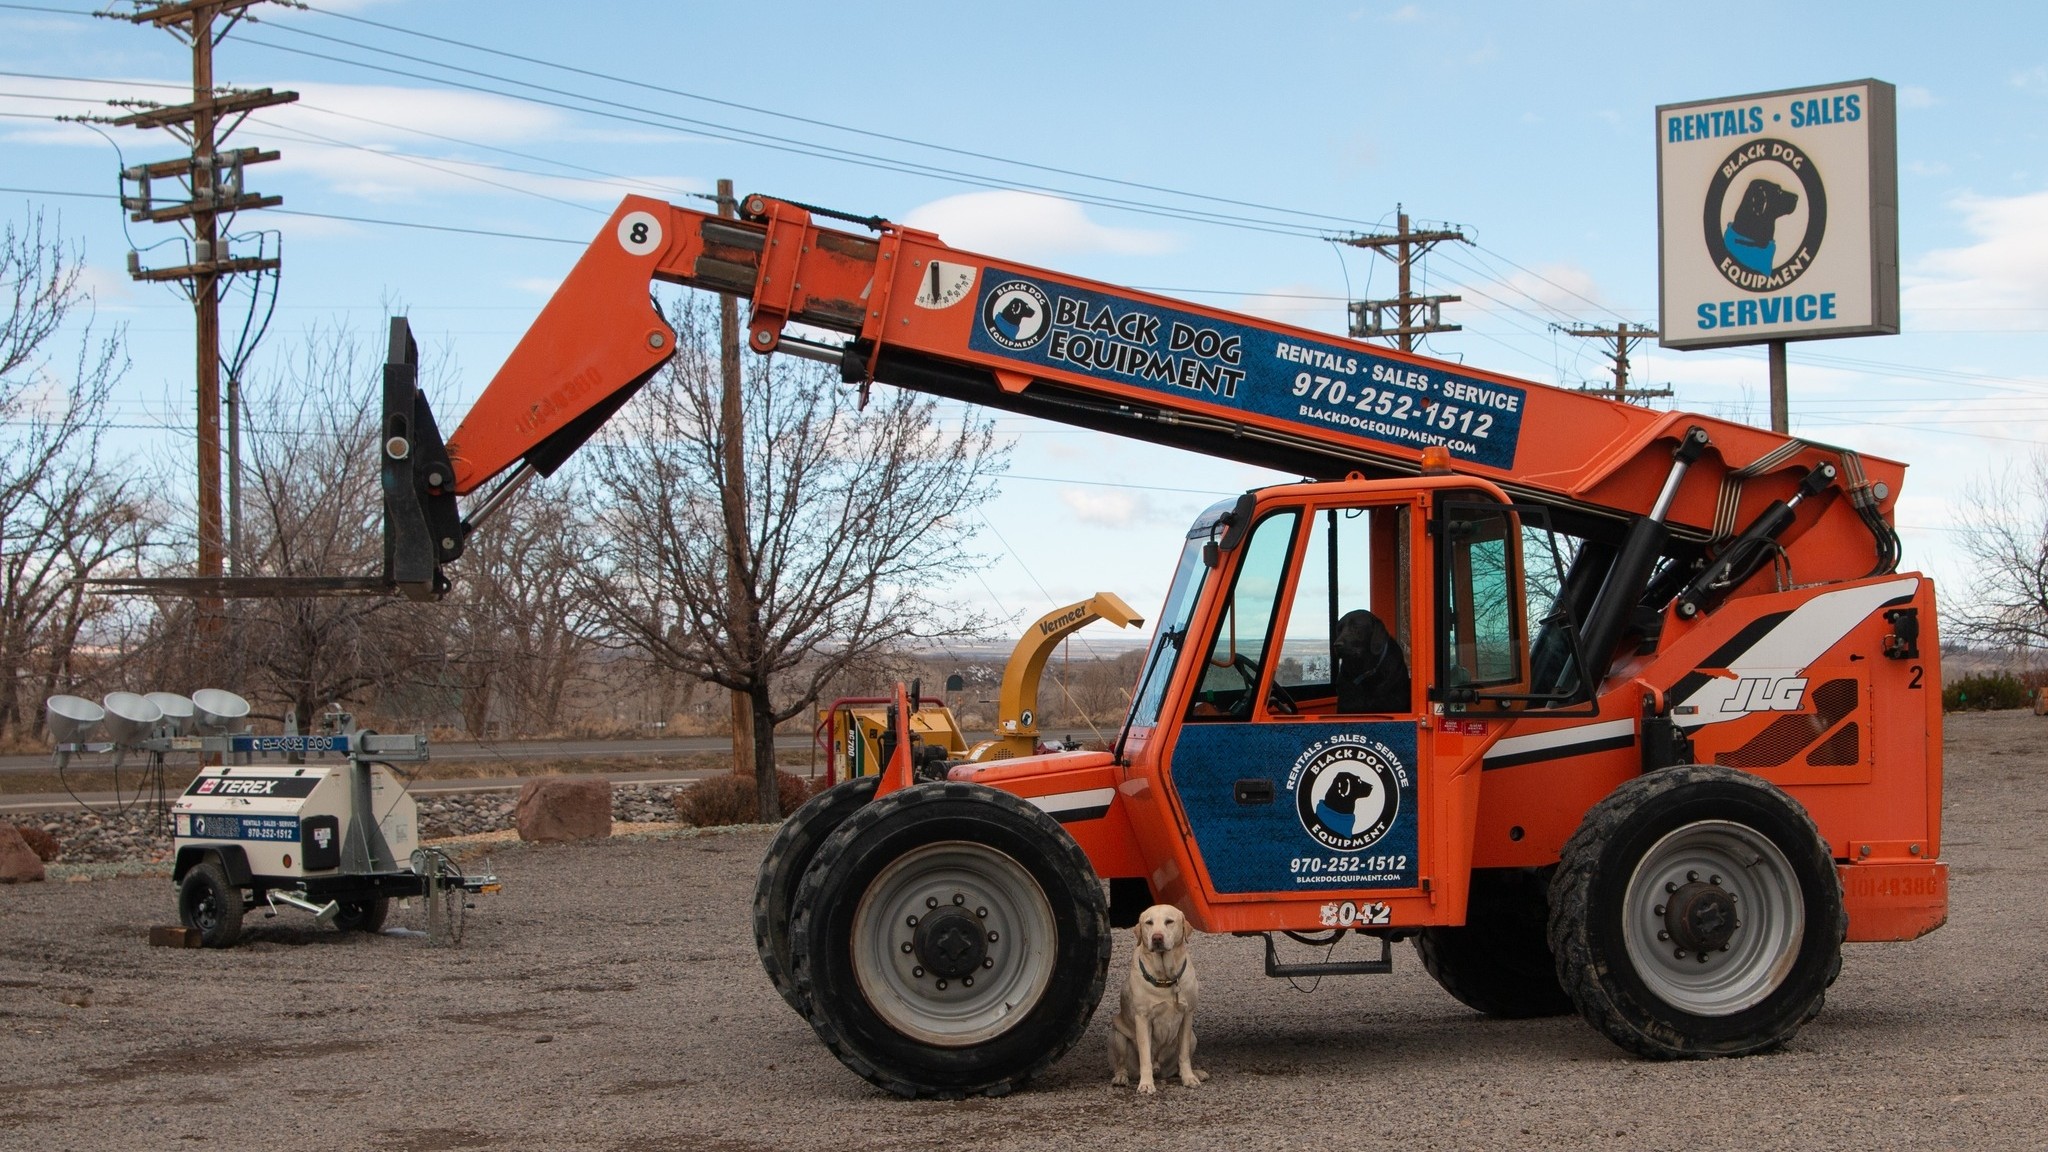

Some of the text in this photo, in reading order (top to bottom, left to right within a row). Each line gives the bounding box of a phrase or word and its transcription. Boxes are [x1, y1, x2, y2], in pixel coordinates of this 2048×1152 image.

[1668, 94, 1861, 143] RENTALS SALES
[1723, 143, 1803, 179] BLACK DOG
[629, 222, 649, 244] 8
[1720, 247, 1812, 289] EQUIPMENT
[997, 284, 1046, 305] BLACK DOG
[1697, 293, 1836, 330] SERVICE
[989, 326, 1039, 348] EQUIPMENT
[1055, 296, 1241, 365] BLACK DOG
[1048, 330, 1246, 398] EQUIPMENT
[1276, 342, 1519, 412] RENTALS SALES SERVICE
[1292, 372, 1494, 439] 970-252-1512
[1299, 405, 1477, 455] BLACKDOGEQUIPMENT.COM
[1039, 605, 1087, 636] Vermeer
[1908, 665, 1924, 689] 2
[1720, 677, 1809, 713] JLG
[262, 736, 304, 751] BLACK
[1286, 734, 1409, 790] RENTALS SALES SERVICE
[1310, 749, 1385, 775] BLACK DOG
[219, 780, 279, 794] TEREX
[243, 819, 261, 827] RENTALS
[279, 820, 297, 828] SERVICE
[247, 828, 293, 839] 970-252-1512
[1311, 821, 1386, 848] EQUIPMENT
[1290, 855, 1407, 873] 970-252-1512
[1296, 874, 1401, 883] BLACKDOGEQUIPMENT.COM
